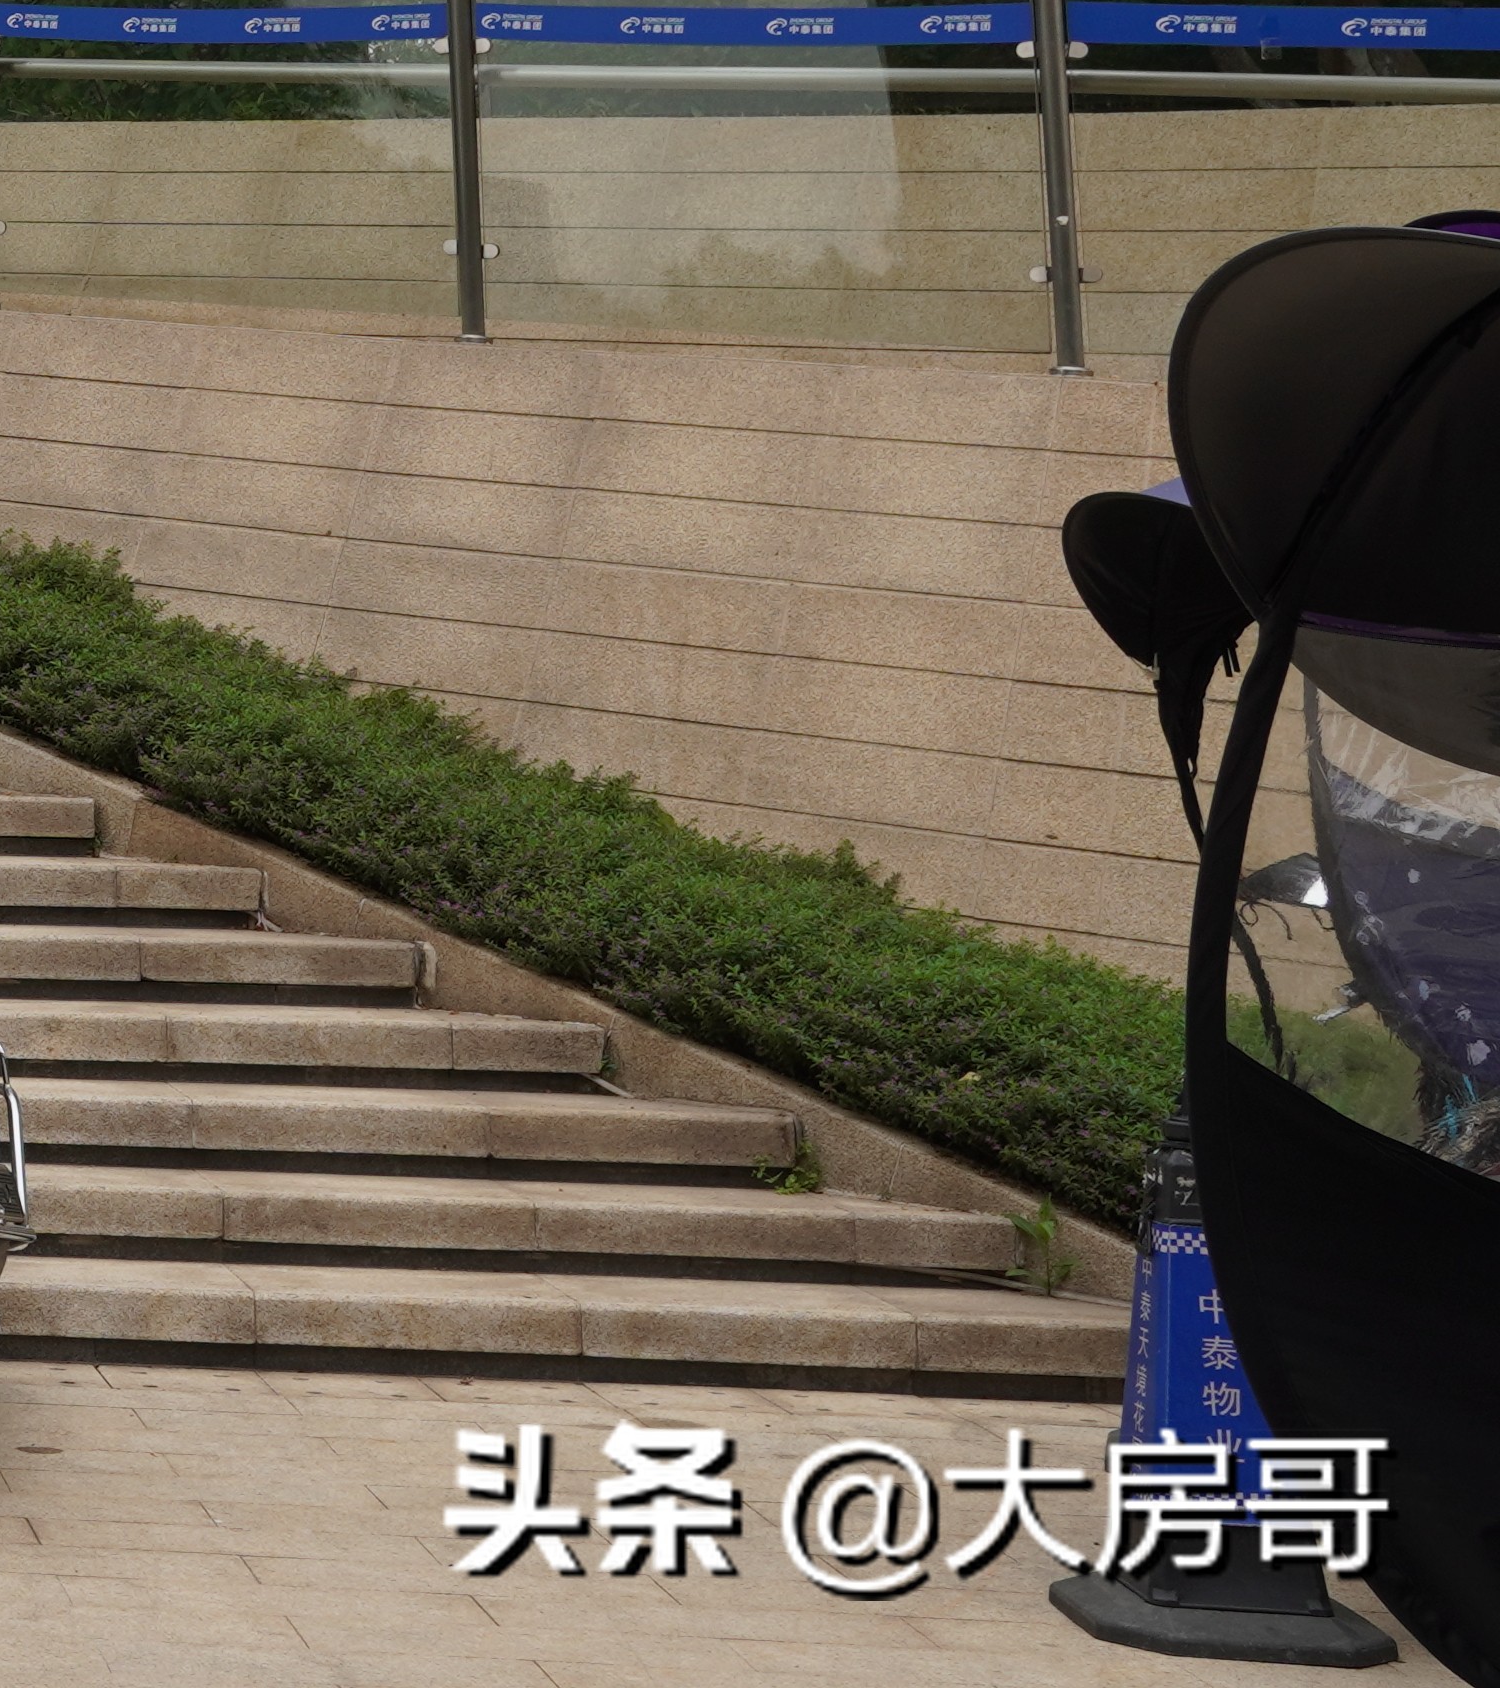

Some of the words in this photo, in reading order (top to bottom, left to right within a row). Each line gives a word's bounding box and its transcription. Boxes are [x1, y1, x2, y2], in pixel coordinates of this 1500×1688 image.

[1183, 23, 1236, 34] 中泰集团
[1371, 26, 1426, 37] 中泰集团
